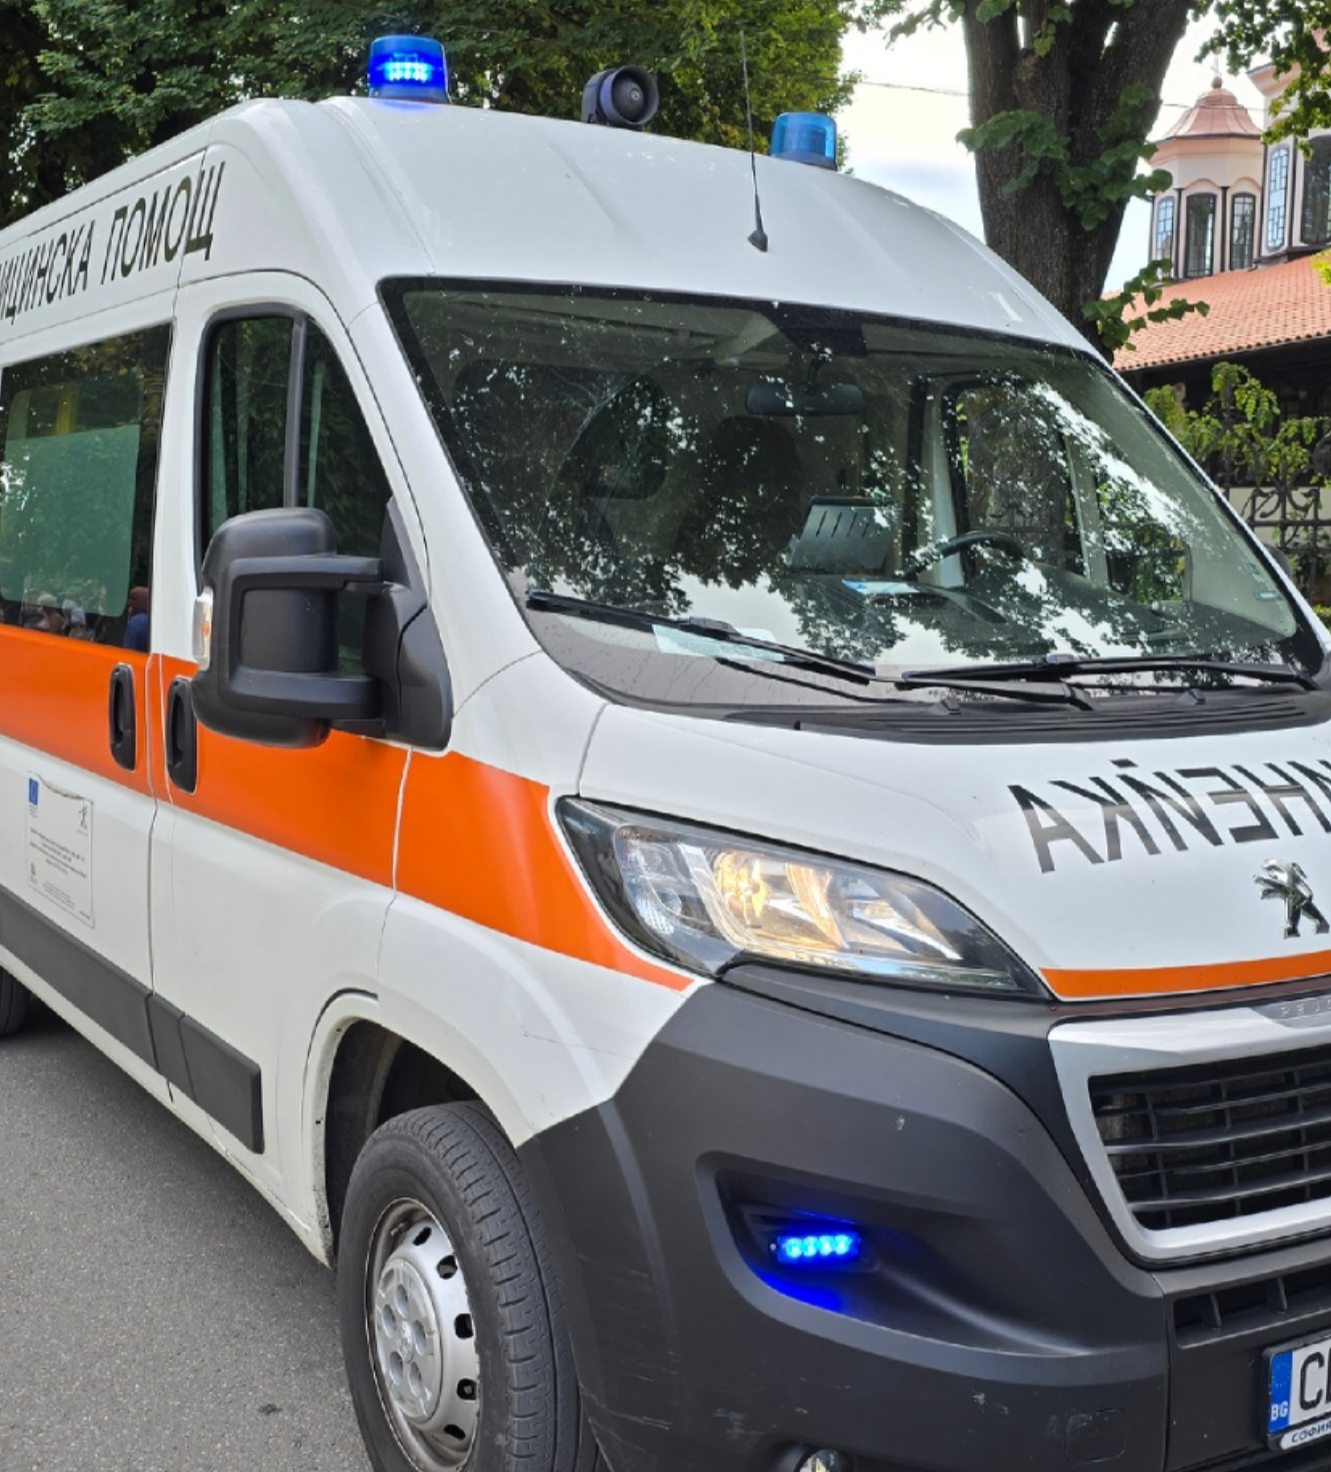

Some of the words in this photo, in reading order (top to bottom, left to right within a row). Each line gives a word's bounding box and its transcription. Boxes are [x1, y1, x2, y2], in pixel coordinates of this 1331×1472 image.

[100, 161, 226, 286] ПОМОЩ
[1299, 1347, 1331, 1411] C
[1270, 1401, 1289, 1422] BG
